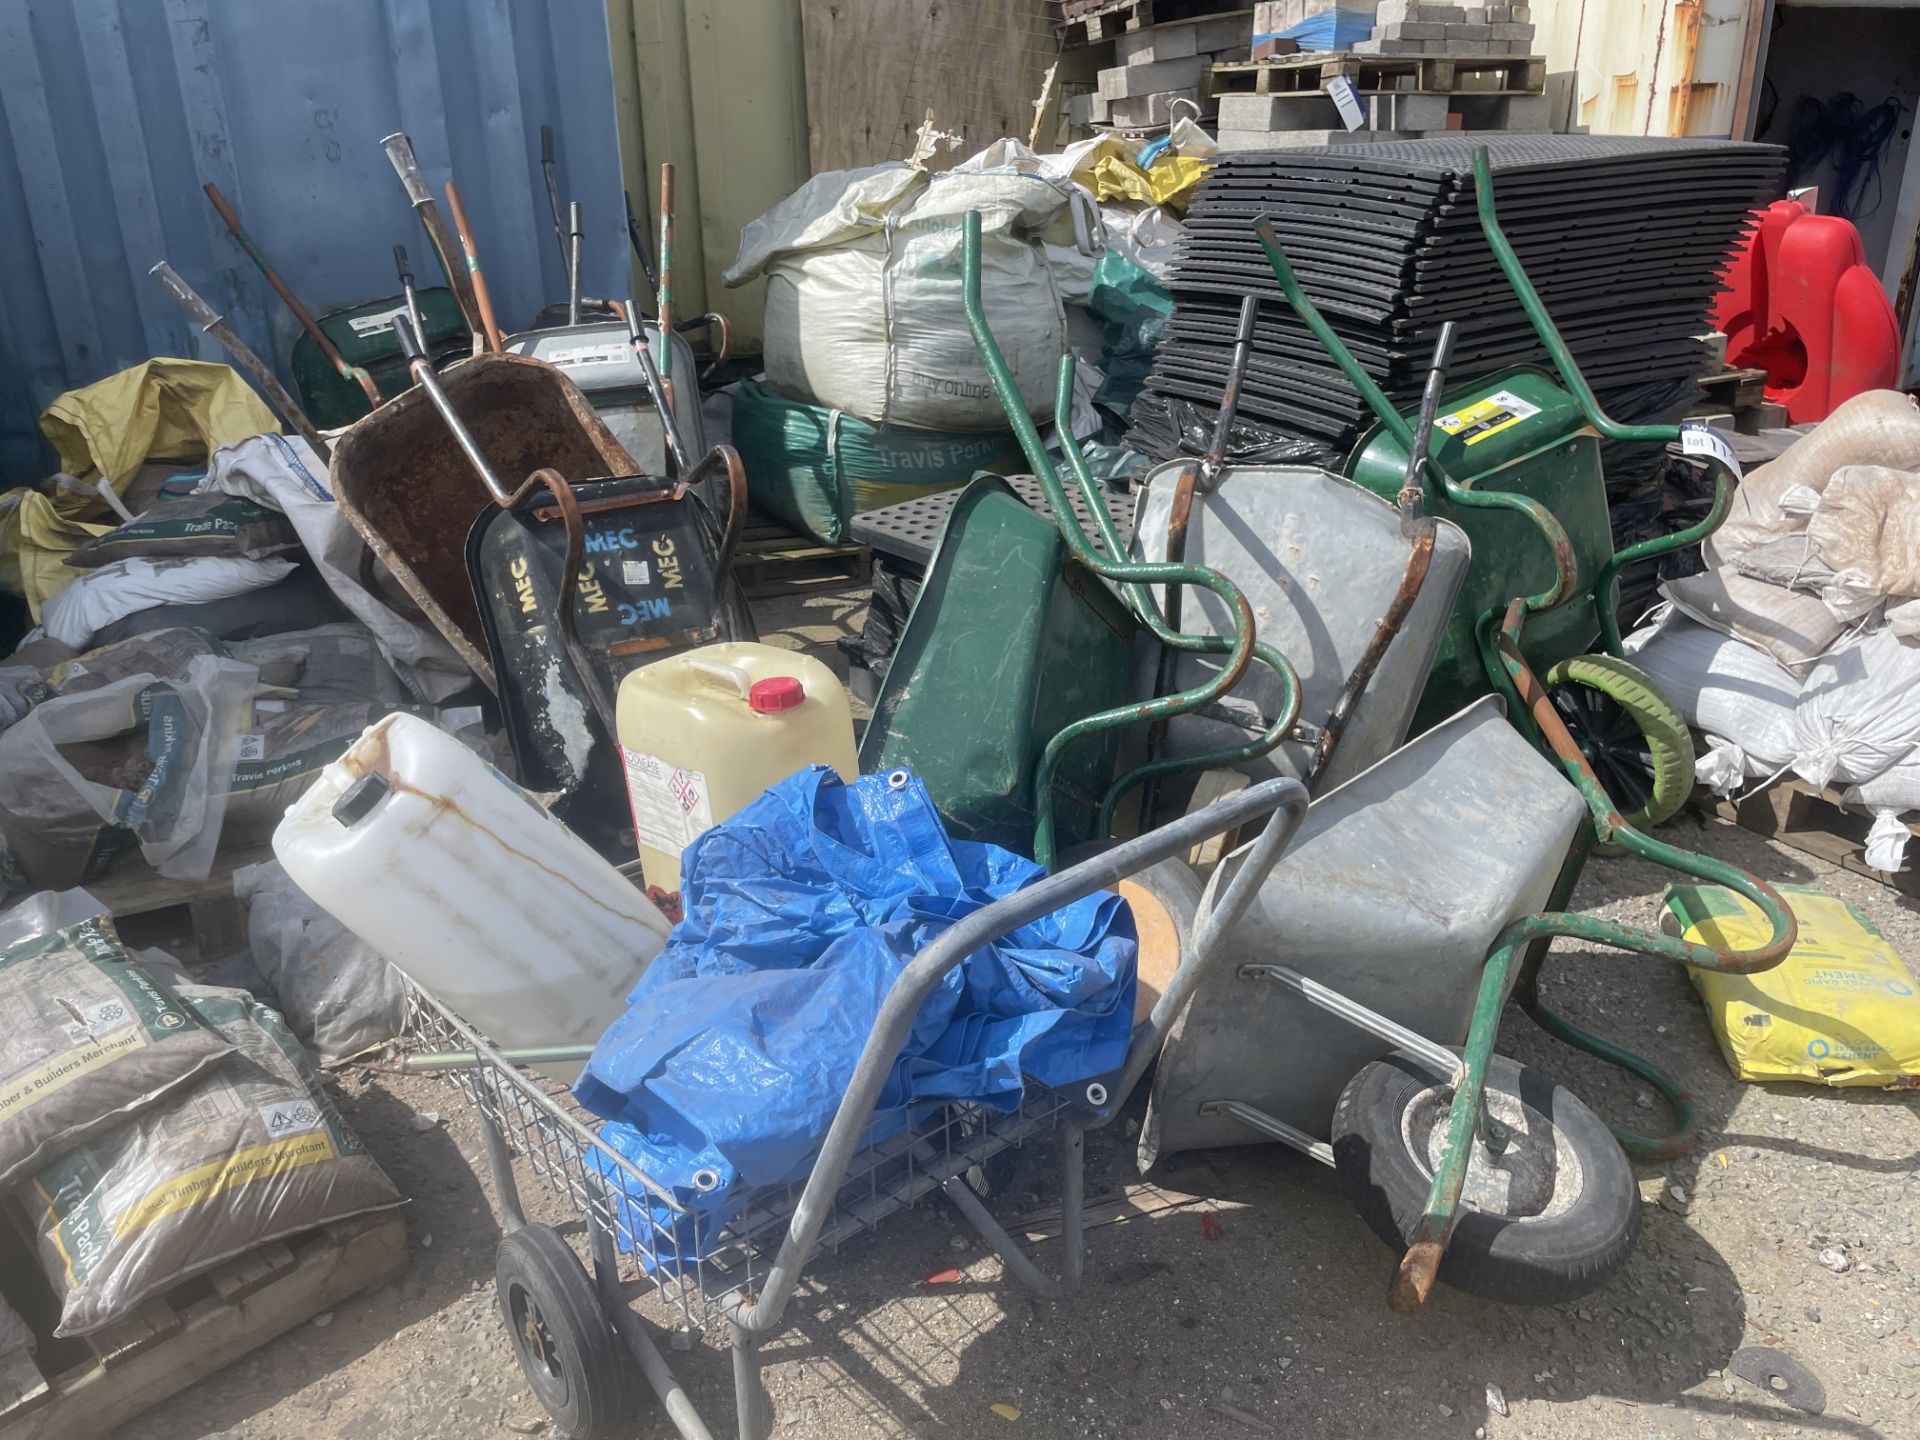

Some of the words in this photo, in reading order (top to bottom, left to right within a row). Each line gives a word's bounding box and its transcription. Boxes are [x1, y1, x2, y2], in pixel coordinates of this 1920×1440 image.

[874, 441, 946, 469] Travis
[184, 520, 212, 533] Trade
[584, 528, 639, 553] MEC
[510, 557, 537, 614] MEC
[578, 561, 609, 614] MEC
[652, 538, 684, 589] MEC
[617, 597, 672, 625] MEC
[231, 770, 264, 783] Travis
[23, 1085, 33, 1095] &
[34, 1059, 81, 1090] Builders
[81, 1035, 137, 1064] Merchant
[171, 1176, 213, 1200] Timber
[274, 1141, 327, 1162] Merchant
[71, 1217, 99, 1271] Pack
